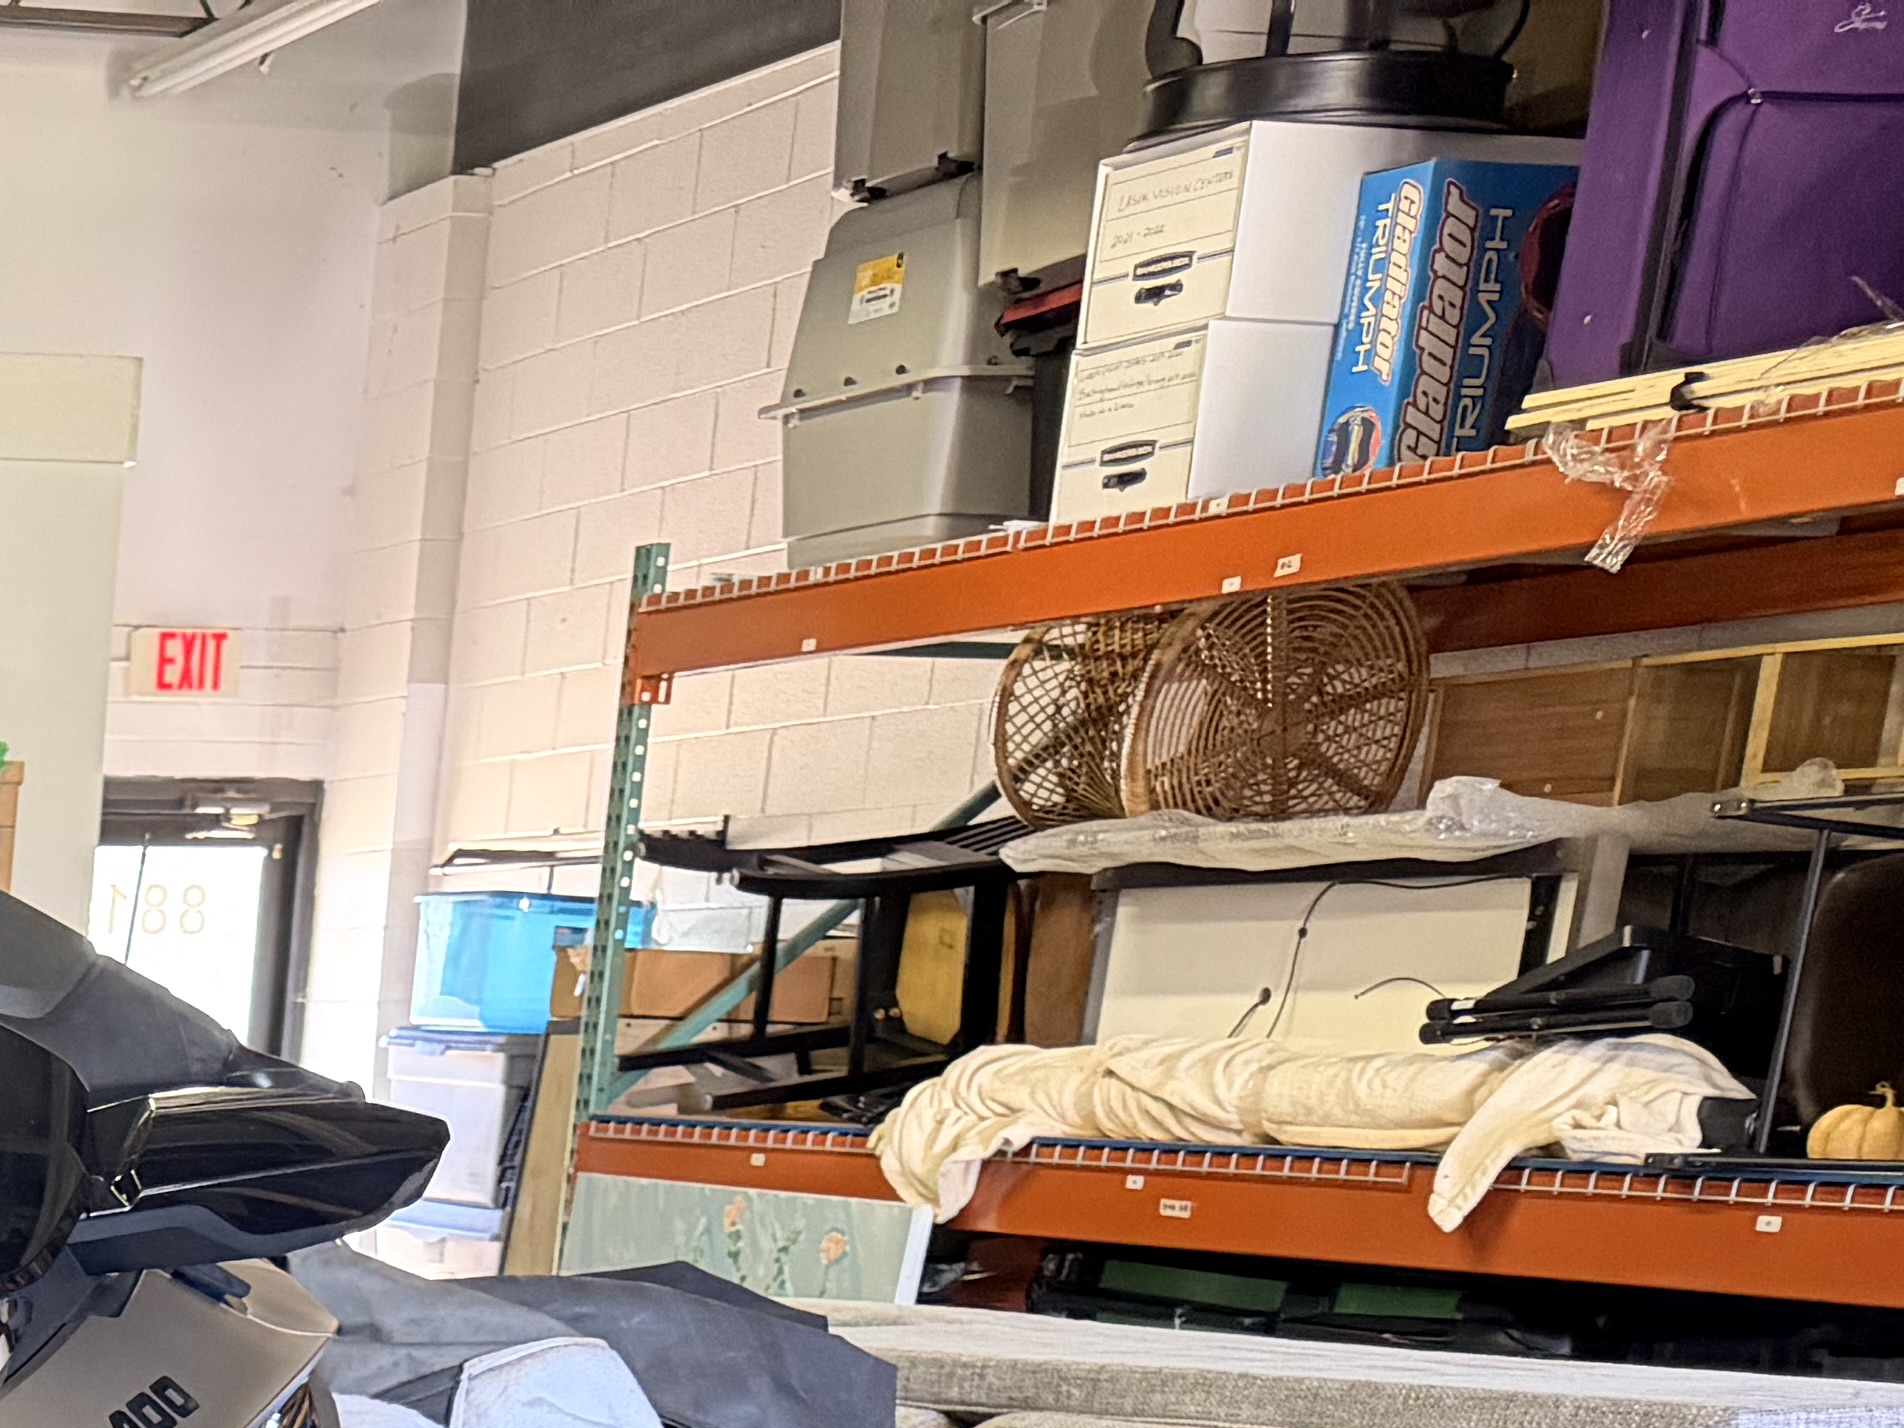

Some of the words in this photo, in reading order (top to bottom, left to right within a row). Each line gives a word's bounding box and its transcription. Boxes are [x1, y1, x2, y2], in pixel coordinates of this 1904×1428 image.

[1351, 193, 1395, 374] TRIUMPH
[1370, 178, 1423, 385] Gladiator
[155, 631, 228, 692] EXIT
